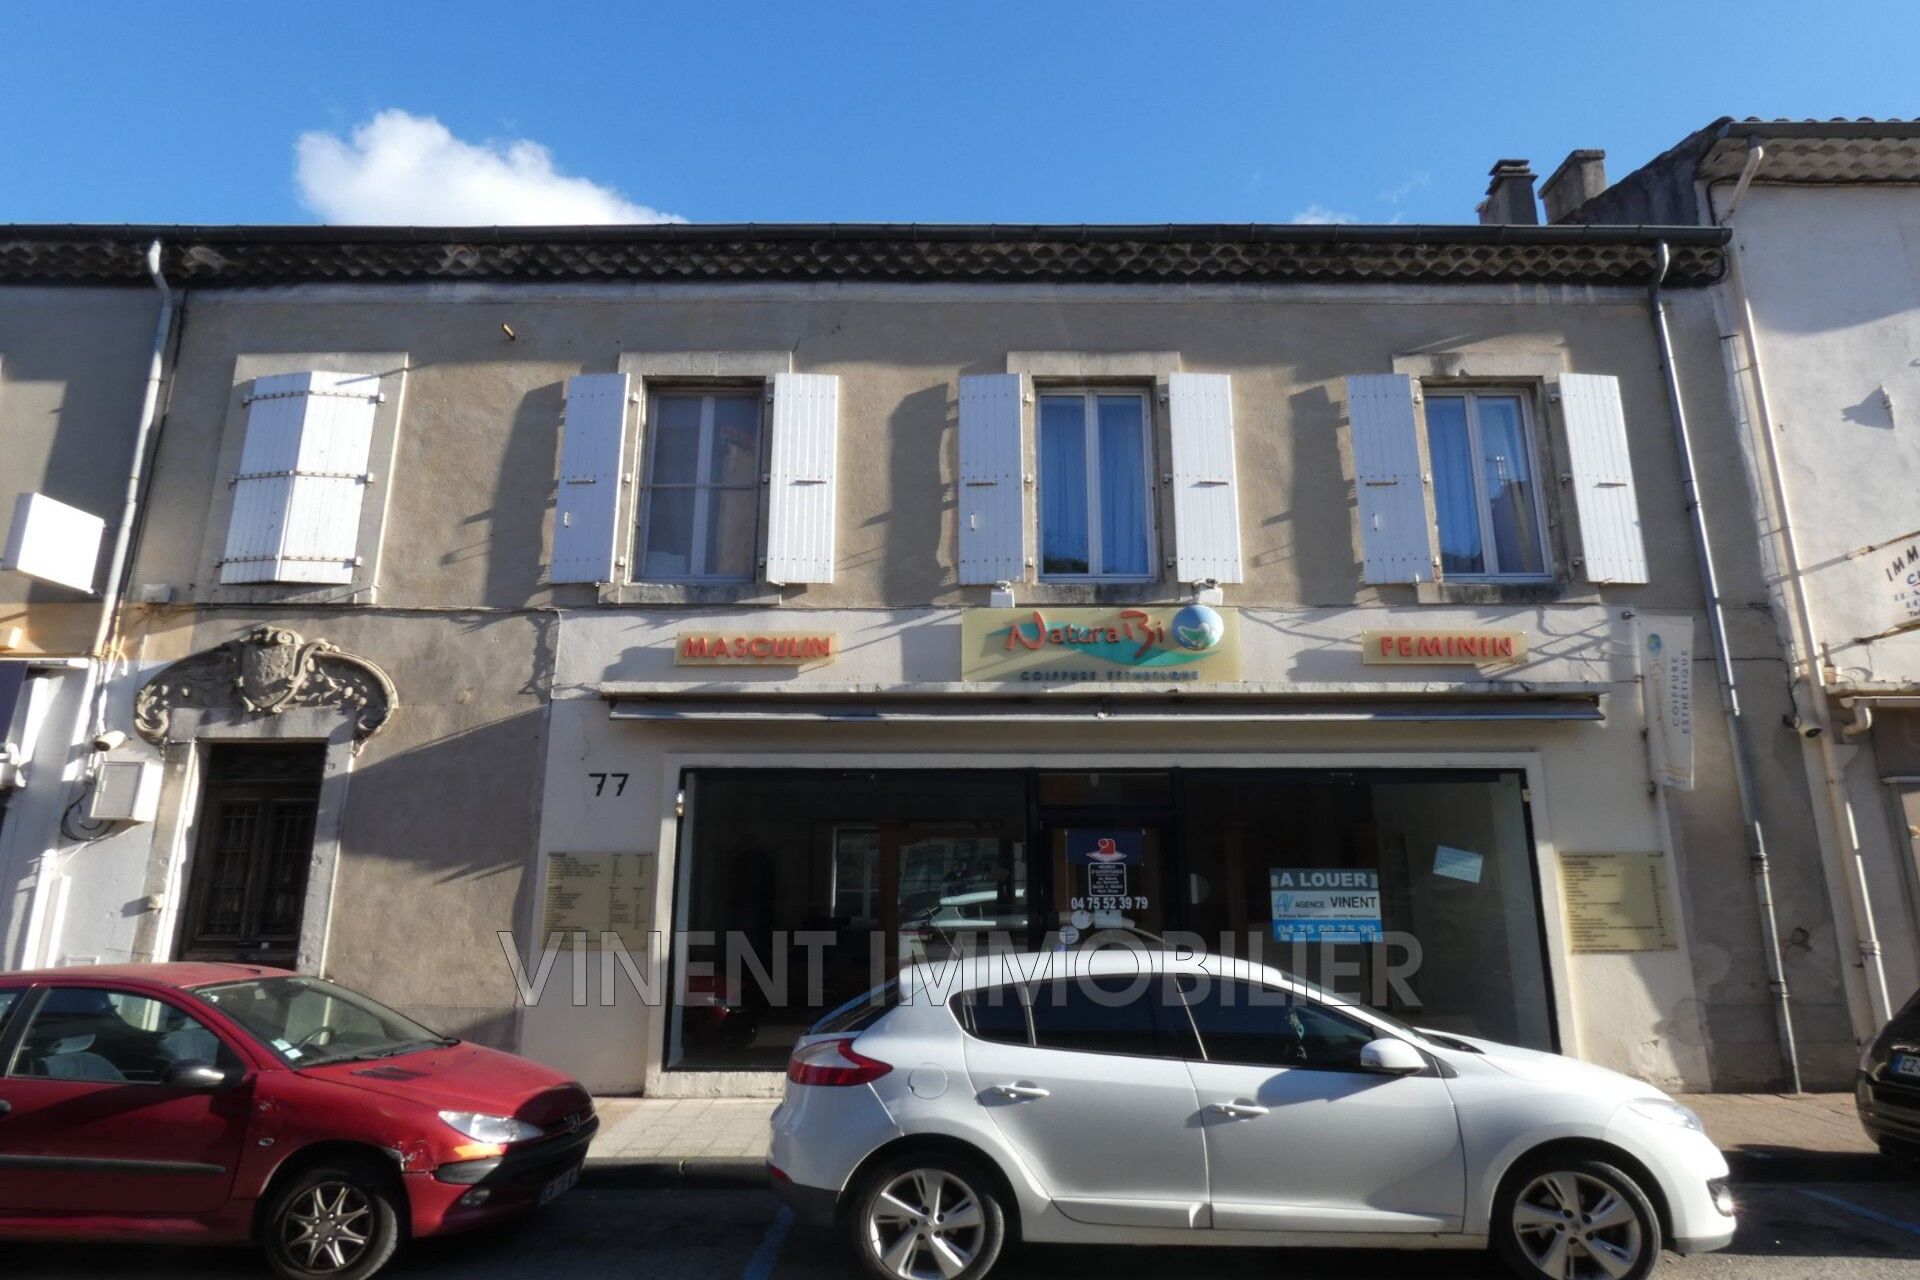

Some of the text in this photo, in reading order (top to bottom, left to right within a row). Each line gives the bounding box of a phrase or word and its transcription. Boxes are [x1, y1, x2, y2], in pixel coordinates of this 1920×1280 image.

[683, 637, 833, 658] MASCULIN
[1380, 637, 1513, 657] FEMININ
[1020, 671, 1096, 682] COIFFURE
[1671, 657, 1680, 728] COIFFURE
[589, 773, 630, 797] 77
[1280, 872, 1368, 888] A LOUER
[1071, 897, 1149, 910] 04 75 52 39 79
[1330, 897, 1376, 908] VINENT
[1277, 924, 1294, 935] 04
